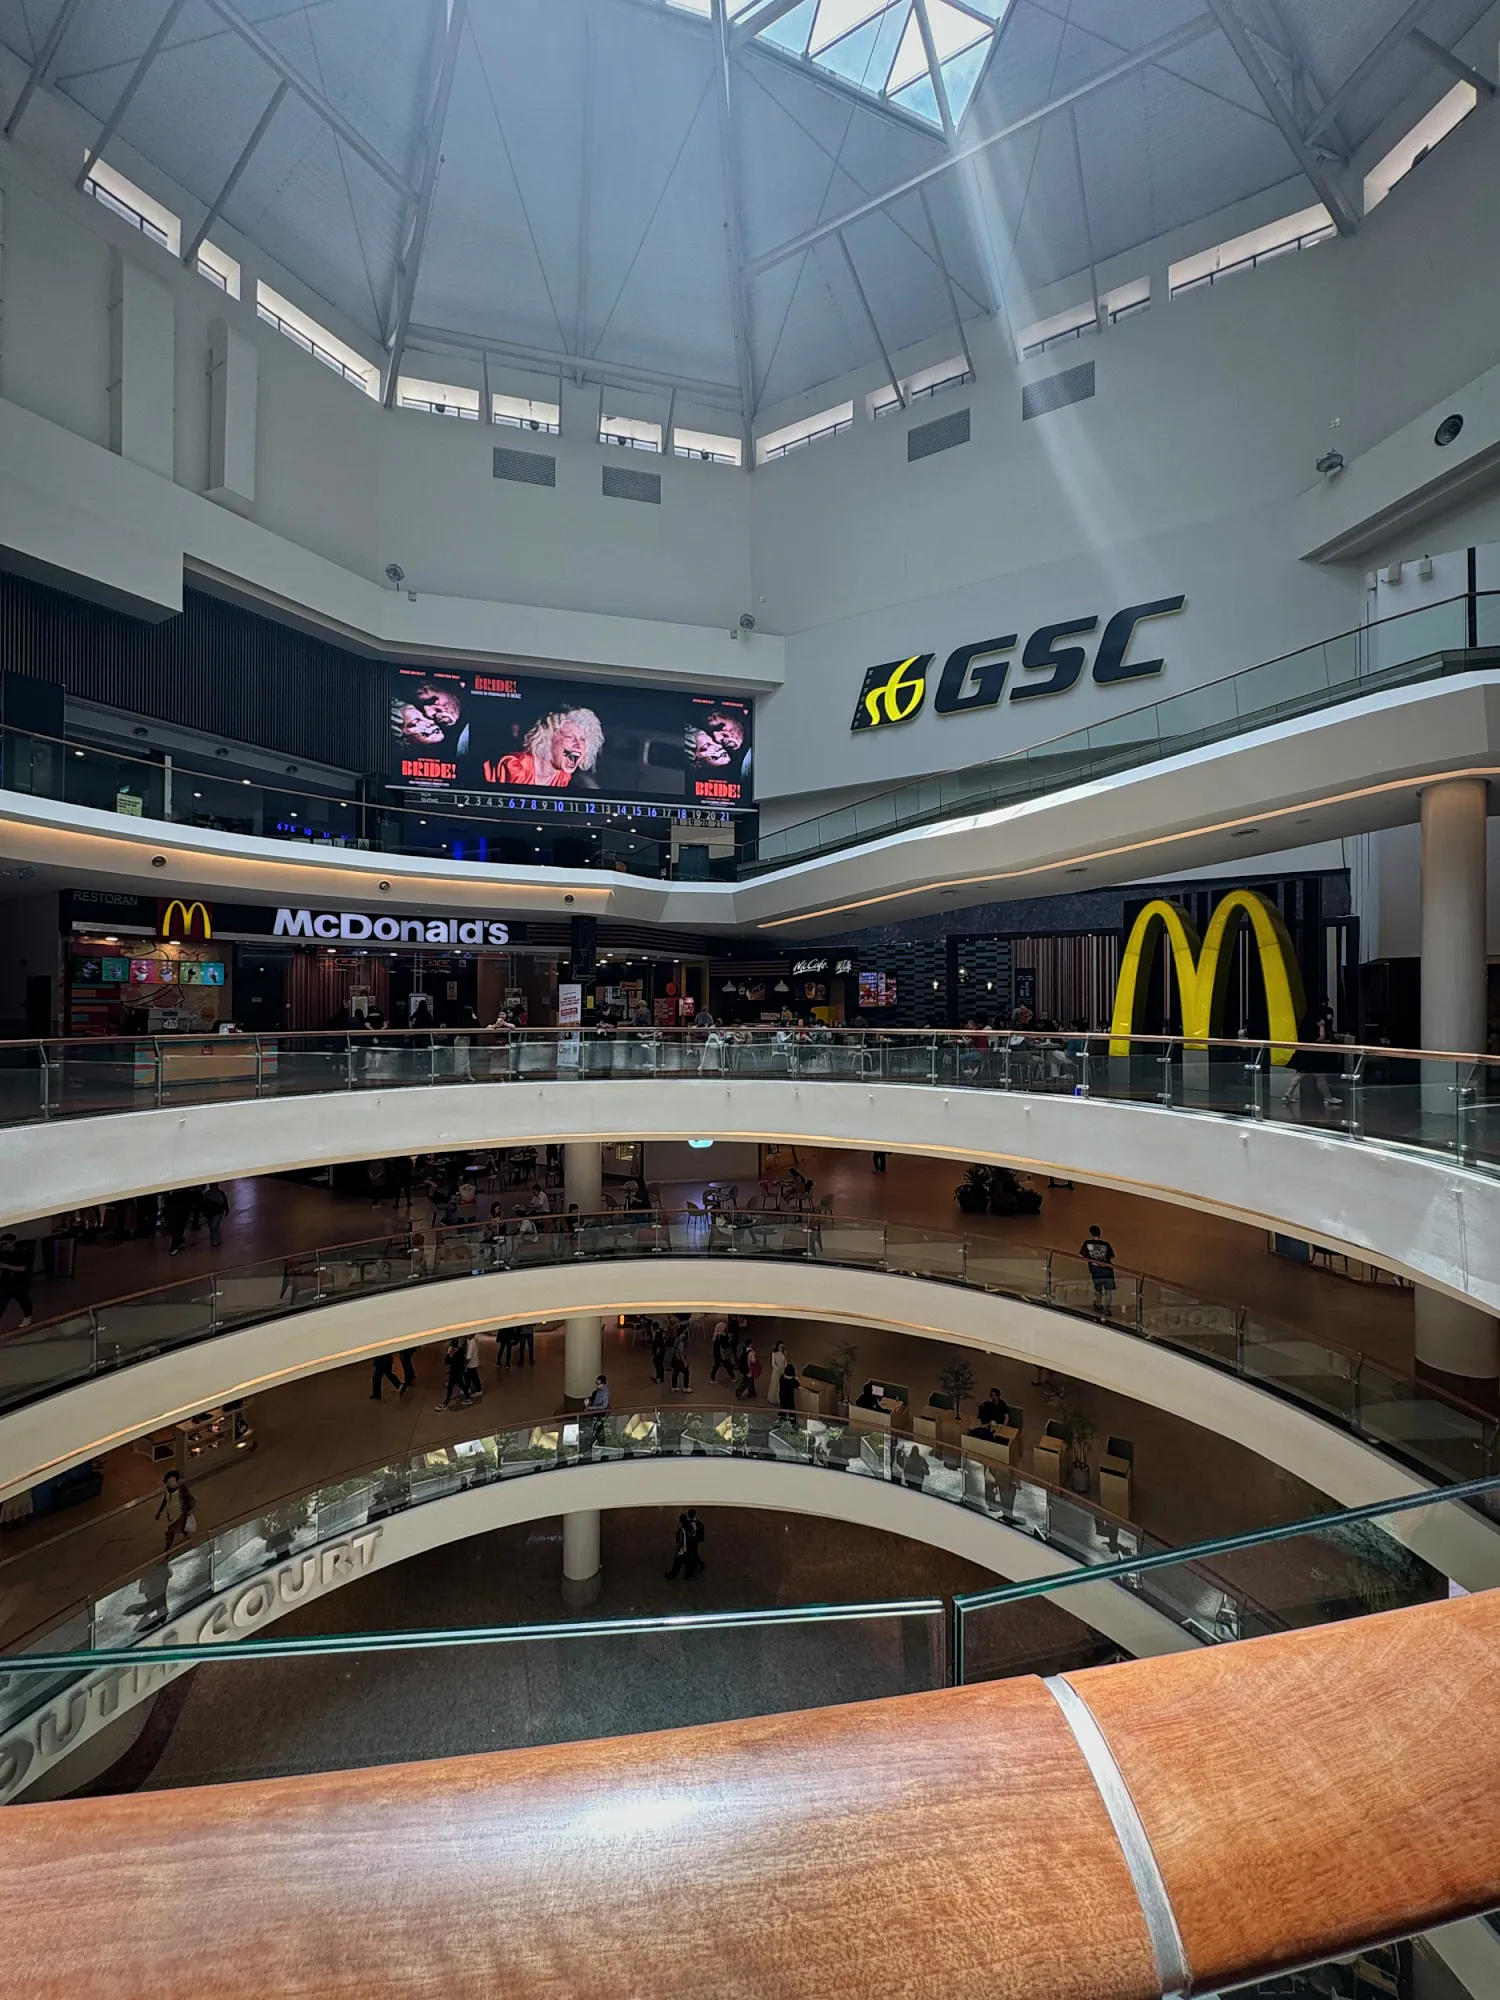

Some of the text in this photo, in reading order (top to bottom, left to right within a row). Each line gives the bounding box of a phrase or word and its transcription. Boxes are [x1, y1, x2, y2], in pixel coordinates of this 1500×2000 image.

[934, 594, 1186, 715] GSC
[474, 676, 517, 693] BRIDE!
[402, 760, 456, 779] BRIDE!
[695, 781, 741, 798] BRIDE!
[454, 795, 458, 804] 1
[464, 796, 470, 805] 2
[476, 796, 481, 806] 3
[487, 797, 492, 806] 4
[498, 798, 504, 807] 5
[509, 798, 515, 808] 6
[520, 799, 526, 809] 7
[531, 800, 537, 810] 8
[542, 800, 547, 810] 9
[554, 801, 564, 812] 10
[570, 802, 579, 812] 11
[585, 803, 595, 814] 12
[601, 804, 611, 814] 13
[617, 805, 626, 815] 14
[632, 806, 641, 816] 15
[648, 807, 657, 817] 16
[662, 808, 671, 818] 17
[677, 809, 687, 819] 18
[692, 810, 701, 819] 19
[706, 811, 716, 820] 20
[720, 812, 730, 821] 21
[73, 890, 138, 906] RESTORAN
[273, 908, 509, 945] McDonald's
[198, 1525, 384, 1645] COURT
